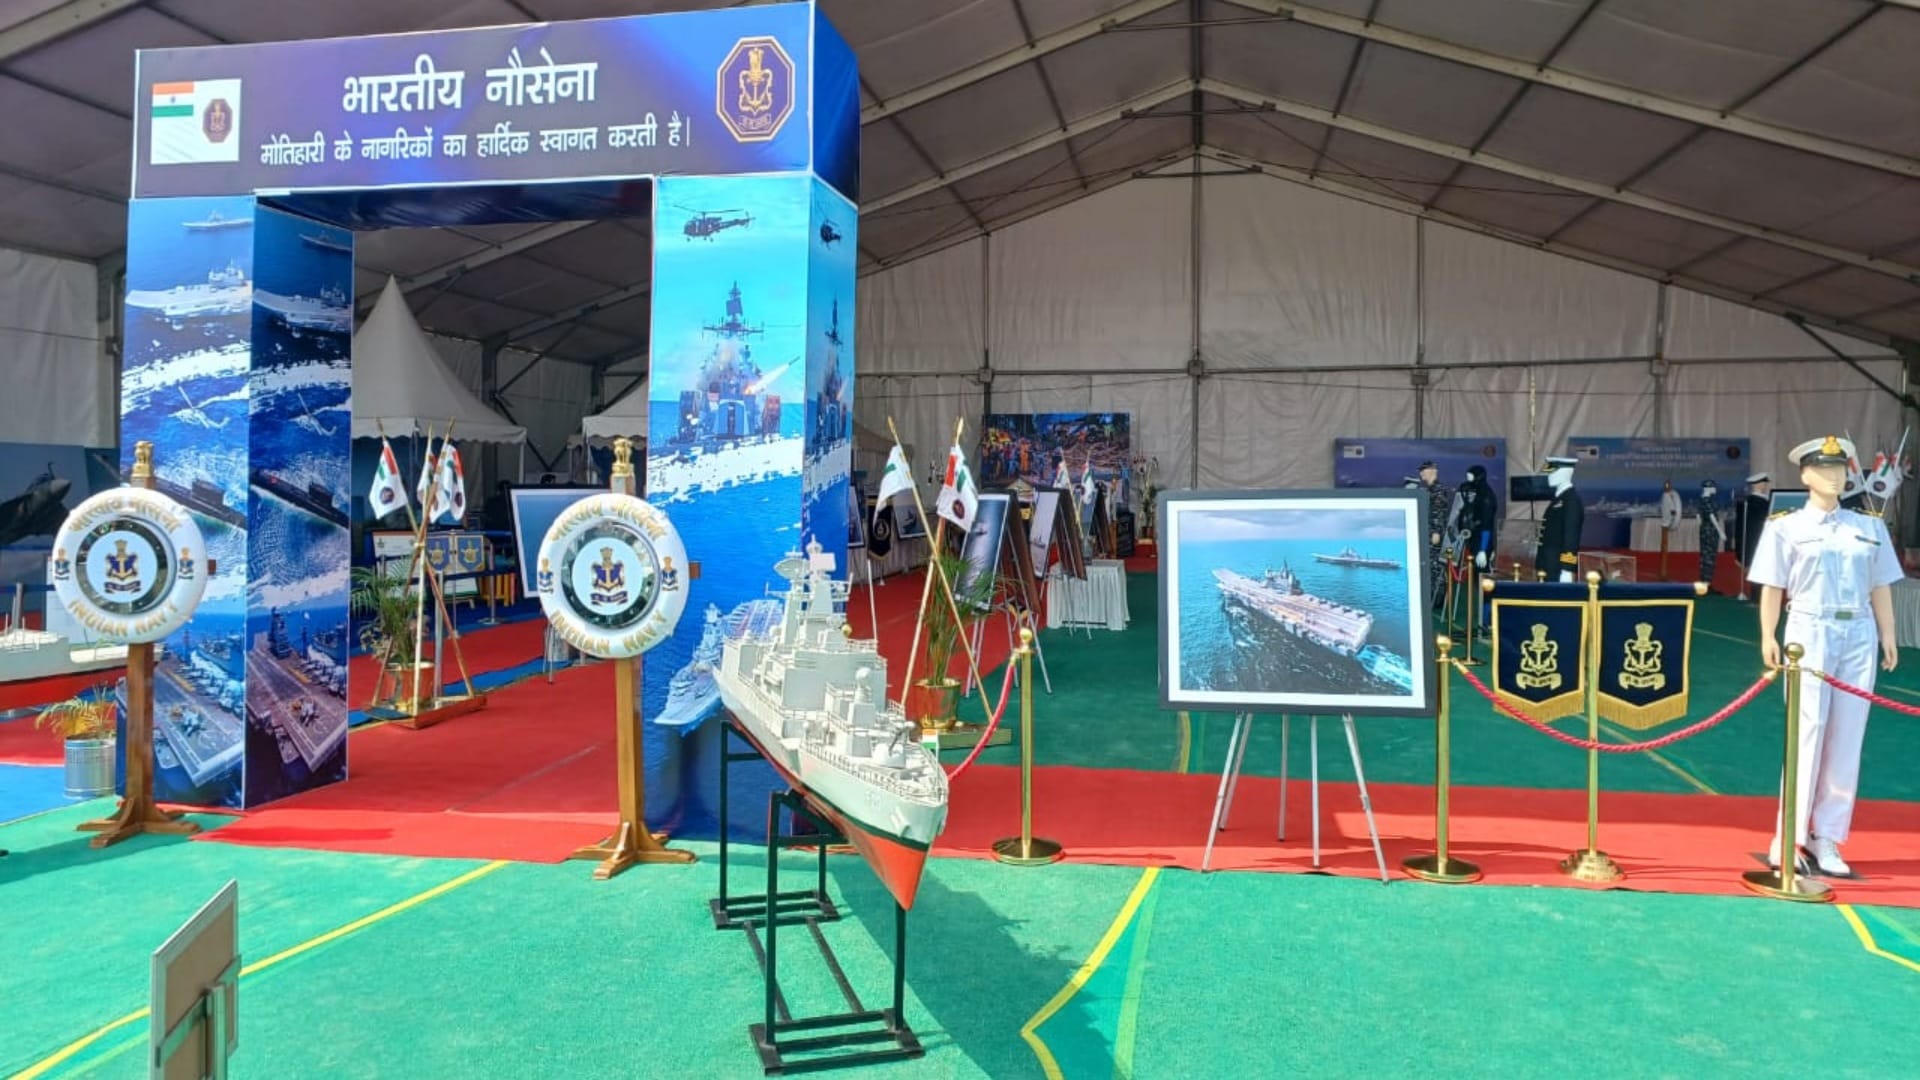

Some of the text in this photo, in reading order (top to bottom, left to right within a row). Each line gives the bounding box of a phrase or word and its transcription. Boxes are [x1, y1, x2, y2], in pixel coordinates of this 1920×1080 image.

[342, 46, 598, 114] भारतीय नौसेना
[260, 130, 326, 166] मोतिहारी
[334, 130, 353, 162] के
[361, 126, 434, 160] नागरिकों
[442, 133, 468, 158] का
[476, 121, 531, 158] हार्दिक
[540, 126, 599, 153] स्वागत
[607, 112, 657, 149] करती
[69, 599, 129, 637] INDIAN
[551, 610, 611, 654] INDIAN
